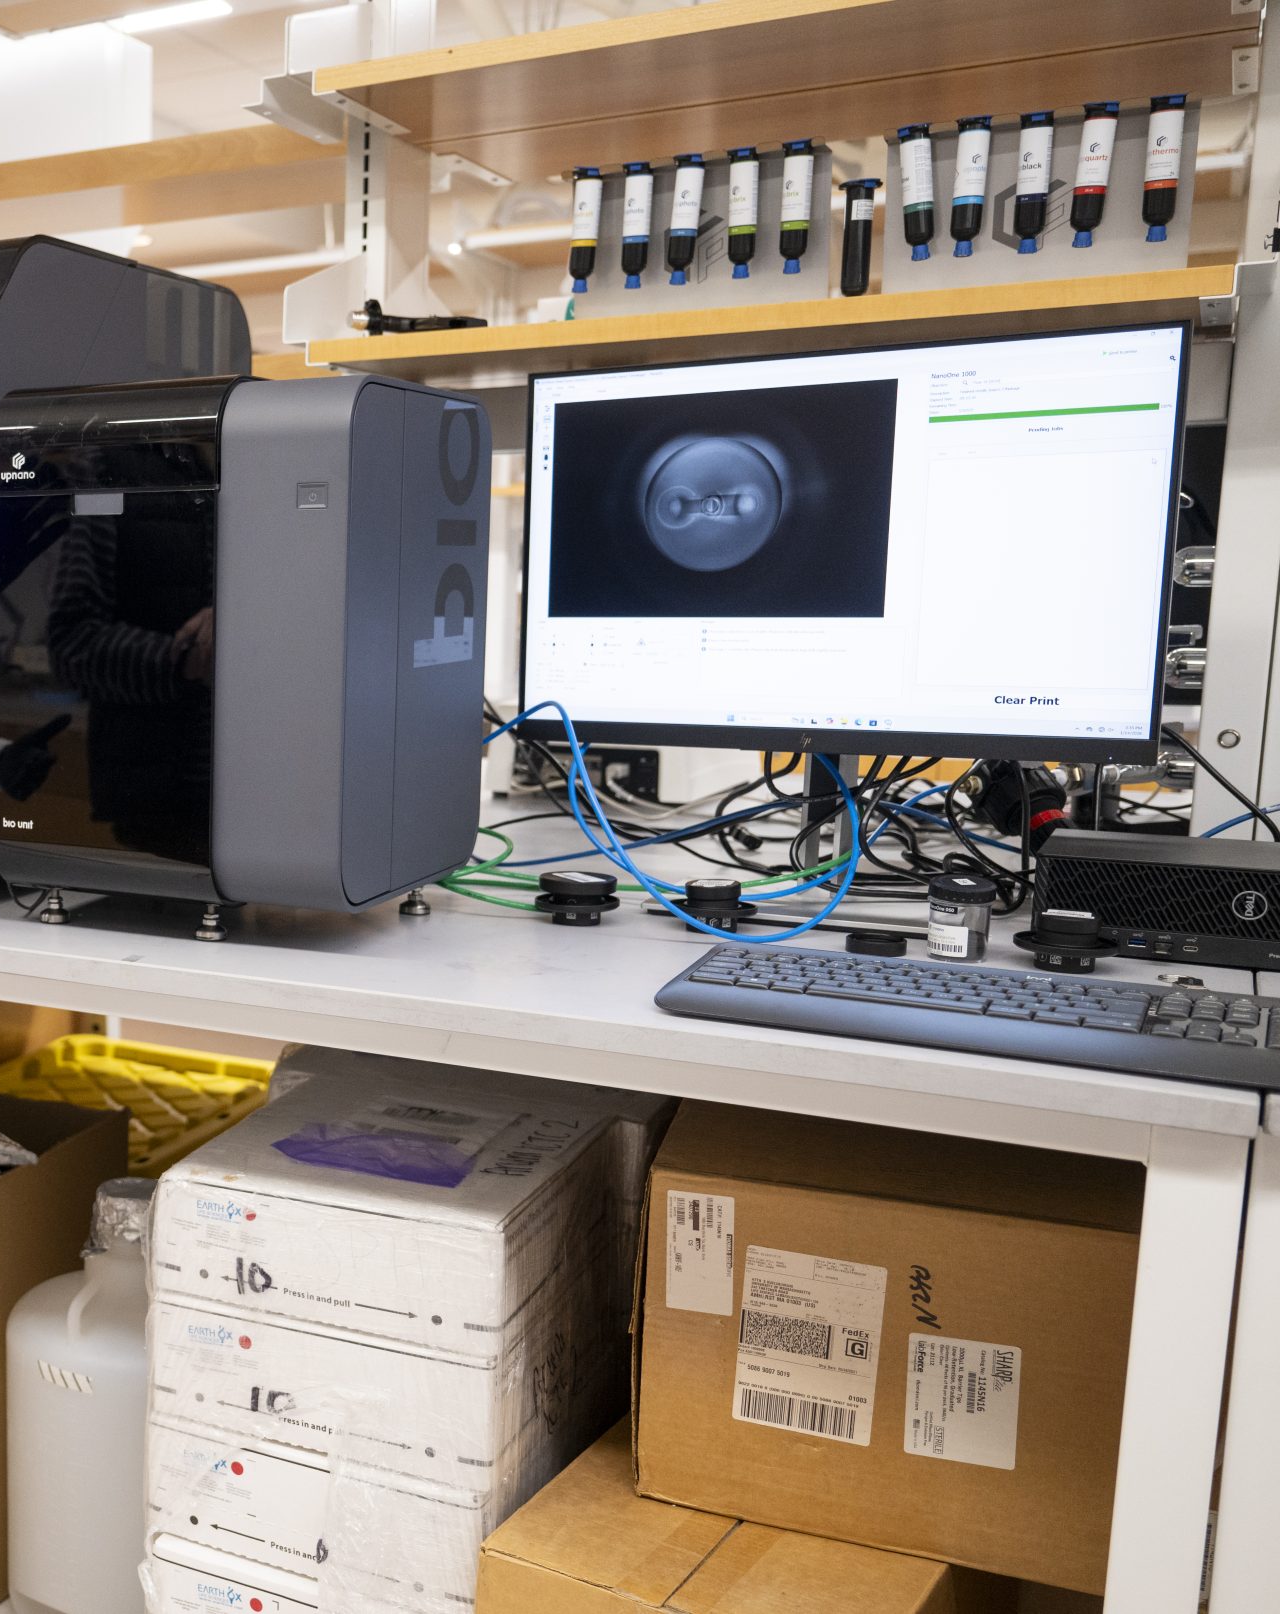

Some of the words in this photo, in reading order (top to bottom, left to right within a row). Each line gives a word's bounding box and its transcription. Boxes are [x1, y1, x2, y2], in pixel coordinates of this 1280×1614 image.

[1084, 154, 1108, 162] quartz
[0, 470, 35, 482] upnano
[994, 696, 1026, 705] Clear
[1030, 696, 1060, 706] Print
[2, 818, 16, 828] bio
[18, 820, 34, 829] unit
[1244, 892, 1256, 917] DELL
[196, 1200, 224, 1212] EARTH
[236, 1256, 272, 1294] 10
[282, 1287, 305, 1300] Press
[306, 1292, 314, 1301] in
[316, 1294, 332, 1305] and
[334, 1298, 350, 1308] pull
[188, 1325, 216, 1336] EARTH
[842, 1328, 870, 1338] FedEx
[850, 1342, 865, 1356] G
[992, 1350, 1014, 1382] SHARP
[977, 1377, 987, 1412] 1145N16
[302, 1419, 310, 1428] in
[310, 1422, 326, 1432] and
[934, 1428, 944, 1454] STERILE
[270, 1542, 292, 1554] Press
[293, 1548, 301, 1557] in
[198, 1584, 225, 1597] EARTH
